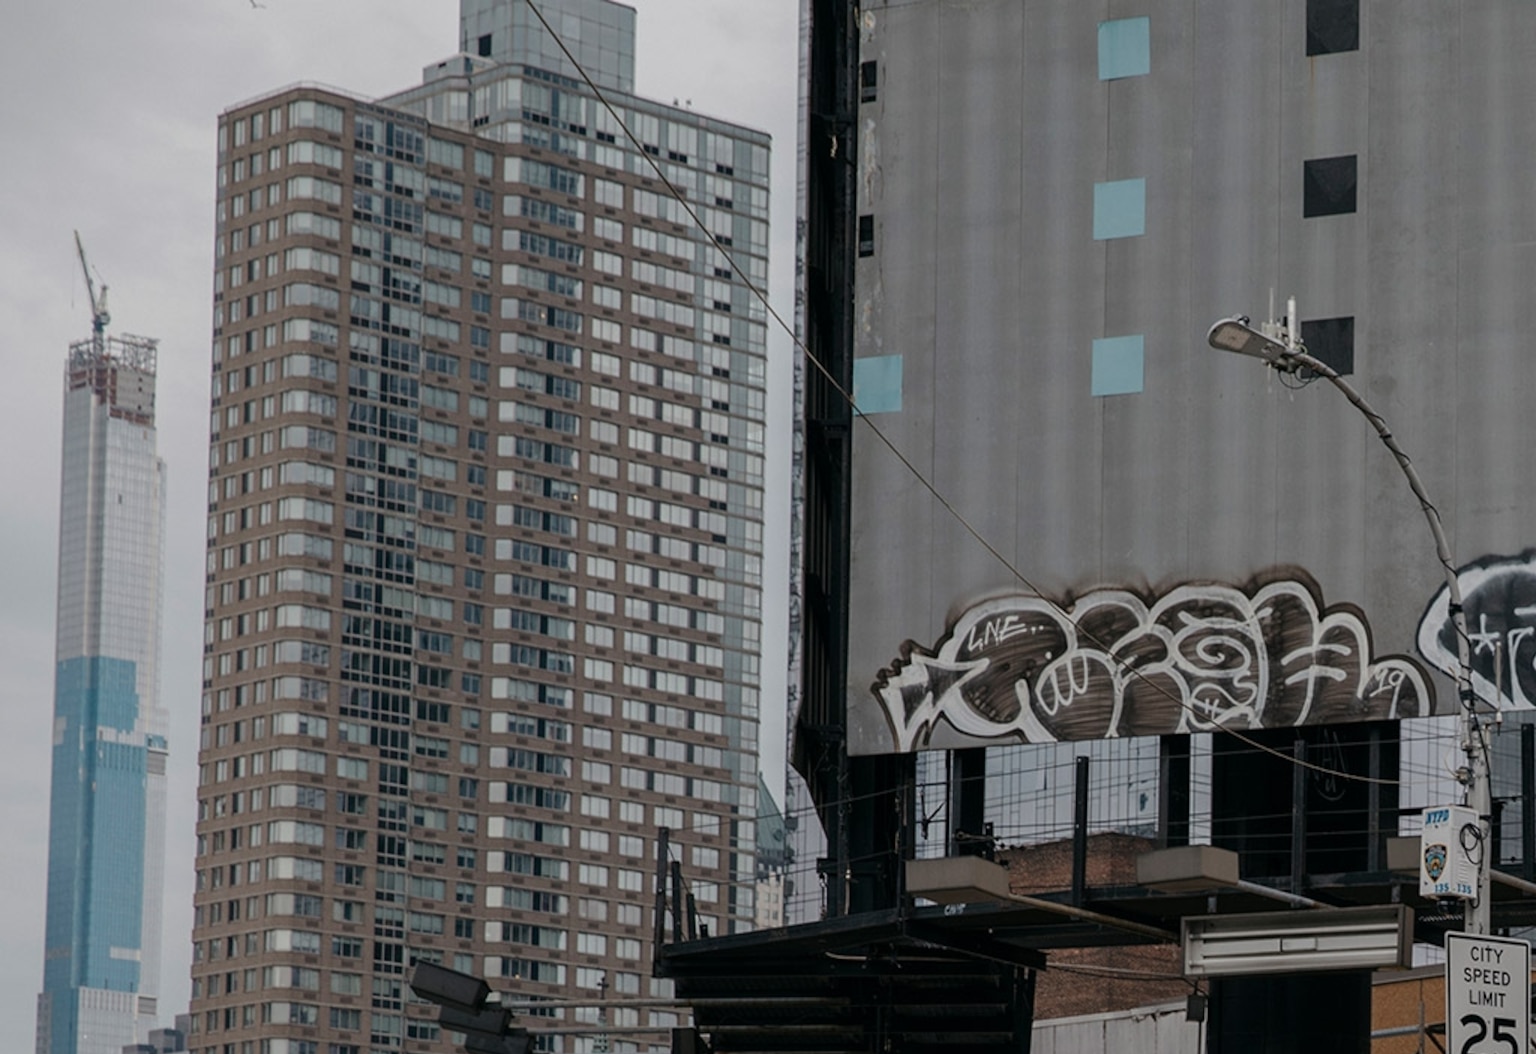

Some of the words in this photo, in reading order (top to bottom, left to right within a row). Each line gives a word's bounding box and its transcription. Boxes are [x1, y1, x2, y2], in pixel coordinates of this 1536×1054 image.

[1425, 809, 1450, 825] NYPD
[1434, 883, 1449, 893] 135
[1457, 883, 1472, 894] 135
[1470, 946, 1504, 964] CITY
[1463, 967, 1511, 987] SPEED
[1469, 988, 1506, 1008] LIMIT
